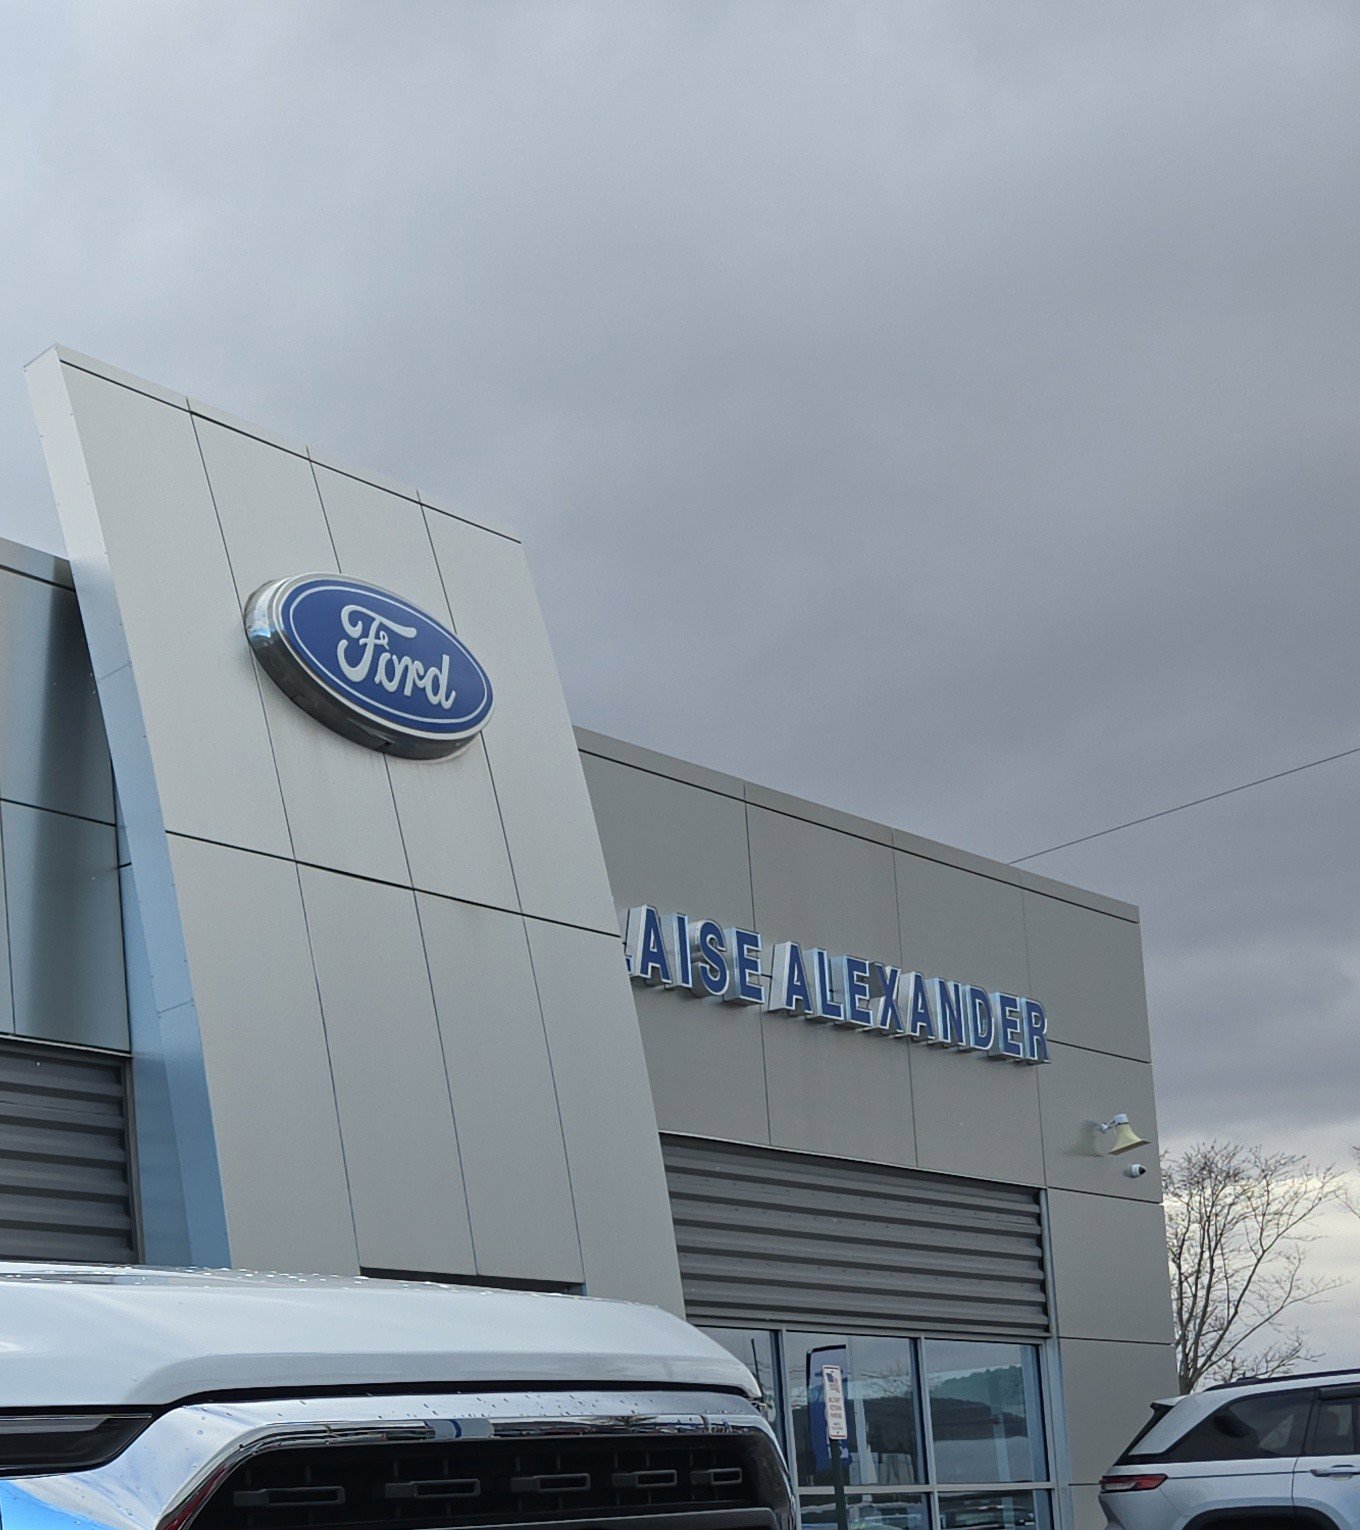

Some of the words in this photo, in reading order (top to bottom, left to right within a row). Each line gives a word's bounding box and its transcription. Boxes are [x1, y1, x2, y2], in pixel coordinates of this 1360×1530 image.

[337, 604, 457, 709] Ford
[625, 904, 765, 1003] AISE
[769, 940, 1051, 1064] ALEXANDER
